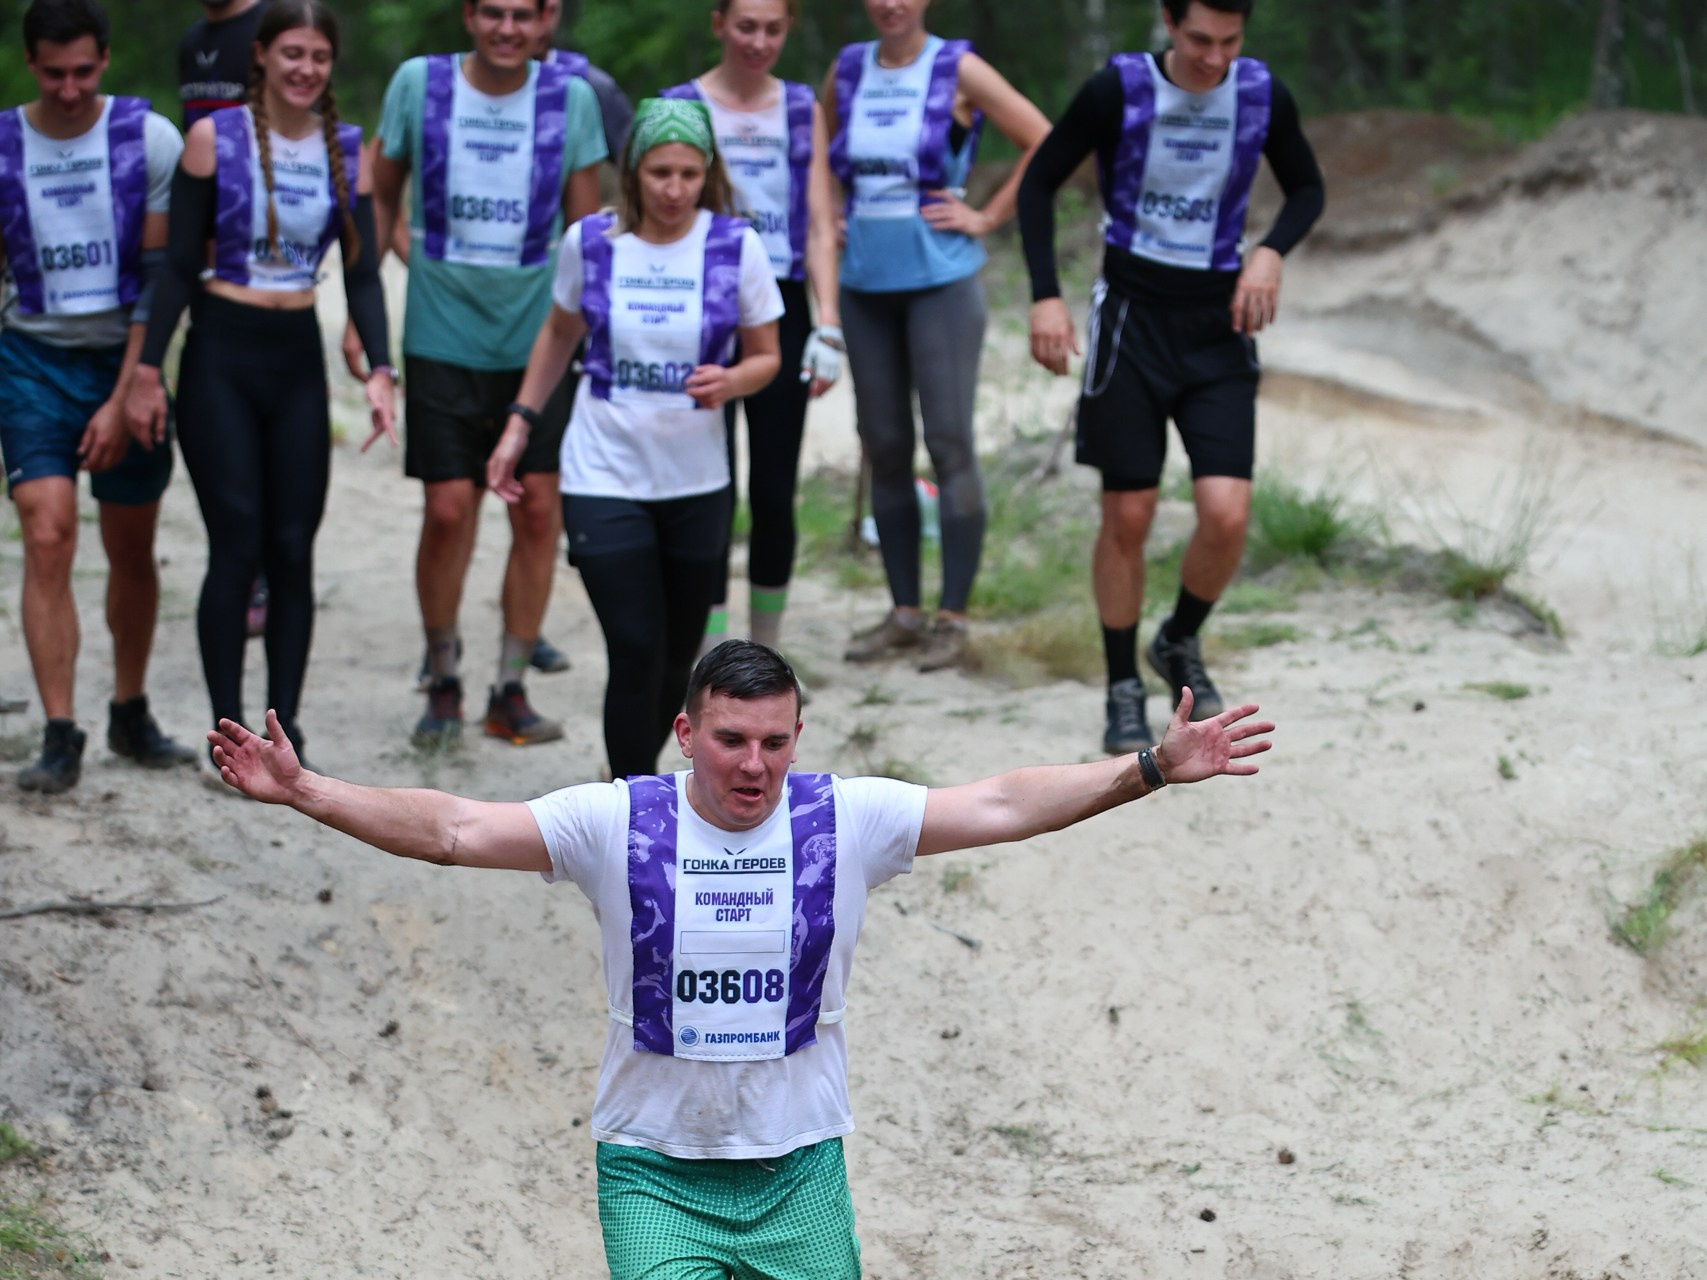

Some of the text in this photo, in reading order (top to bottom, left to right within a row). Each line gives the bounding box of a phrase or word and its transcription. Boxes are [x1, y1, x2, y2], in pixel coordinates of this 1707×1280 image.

[452, 194, 524, 223] 03605
[42, 239, 113, 270] 03601
[617, 359, 695, 387] 03602
[683, 857, 787, 870] ГОНКА ГЕРОЕВ
[695, 888, 774, 908] КОМАНДНЫЙ
[715, 908, 752, 922] СТАРТ
[677, 968, 785, 1004] 03608
[704, 1030, 781, 1045] ГАЗПРОМБАНК
